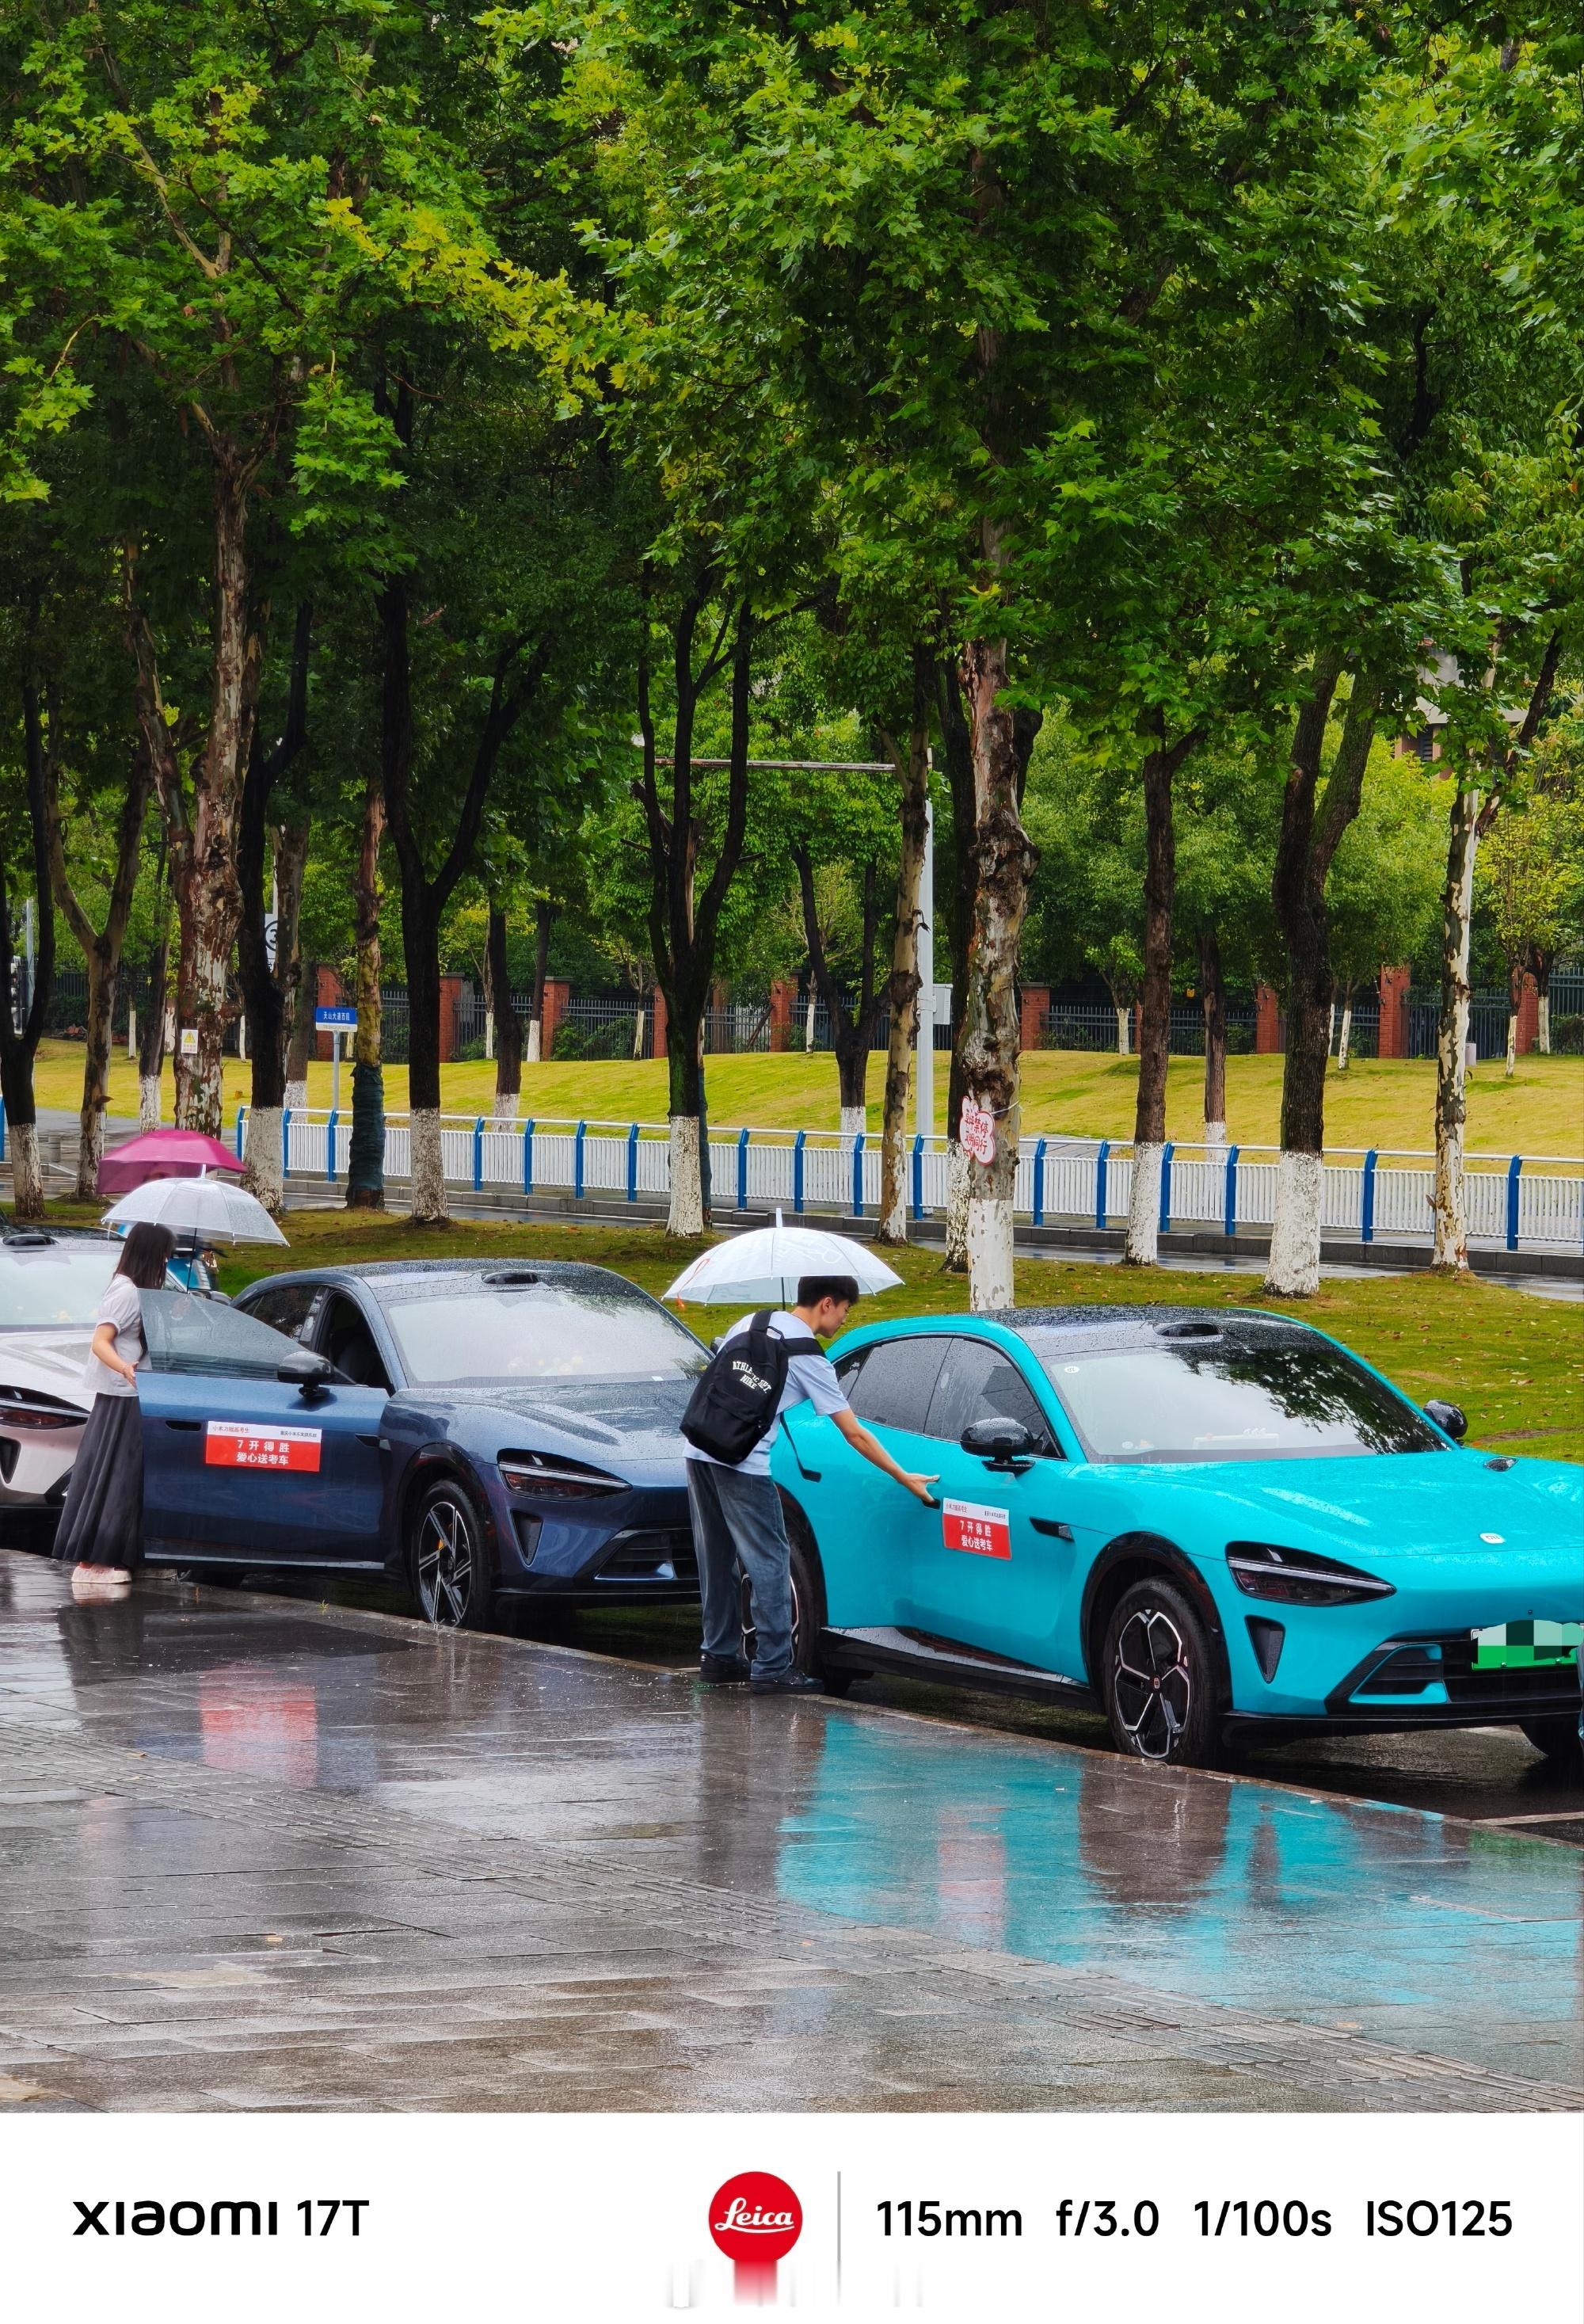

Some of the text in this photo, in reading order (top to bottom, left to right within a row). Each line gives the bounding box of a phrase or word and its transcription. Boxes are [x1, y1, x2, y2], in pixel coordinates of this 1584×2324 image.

[739, 1373, 758, 1390] NIKE
[236, 1451, 289, 1465] 爱心送考车
[961, 1534, 994, 1552] 爱心送考车
